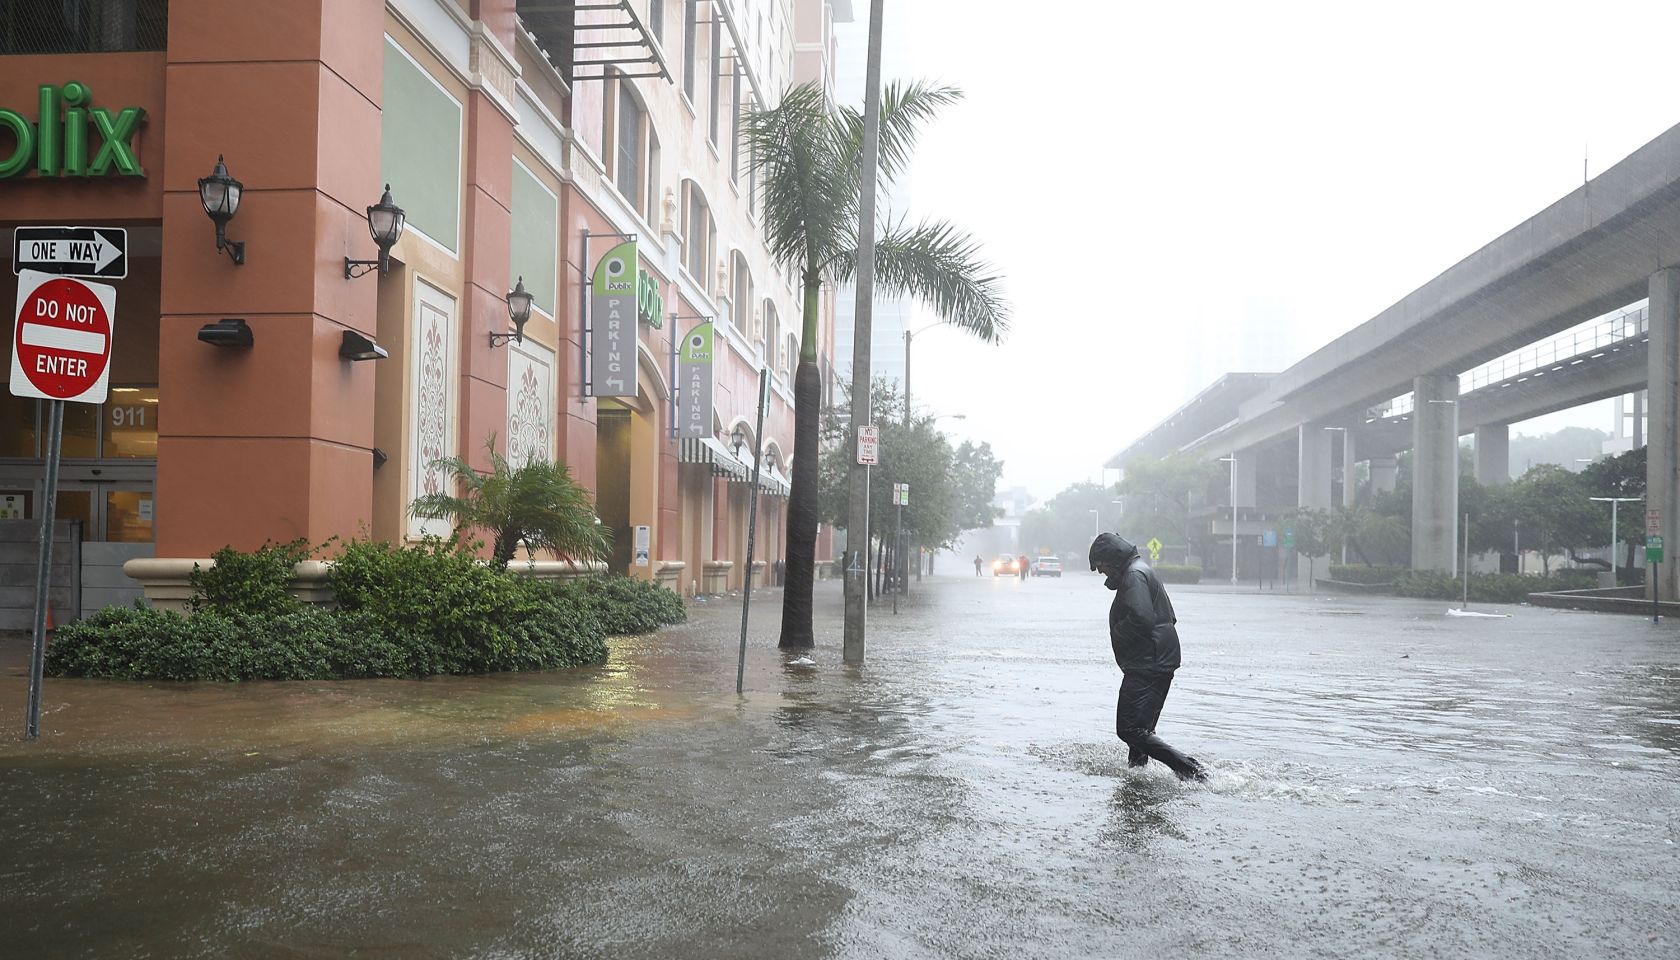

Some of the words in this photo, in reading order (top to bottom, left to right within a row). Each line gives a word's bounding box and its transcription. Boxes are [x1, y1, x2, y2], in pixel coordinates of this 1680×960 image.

[31, 242, 56, 260] ONE
[69, 242, 103, 261] WAY
[608, 282, 632, 290] Publix
[36, 298, 59, 318] DO
[65, 303, 97, 324] NOT
[608, 299, 621, 372] PARKING
[36, 354, 88, 378] ENTER
[691, 366, 701, 421] PARKING
[112, 407, 145, 426] 911
[859, 436, 877, 445] PARKING
[864, 427, 873, 436] NO
